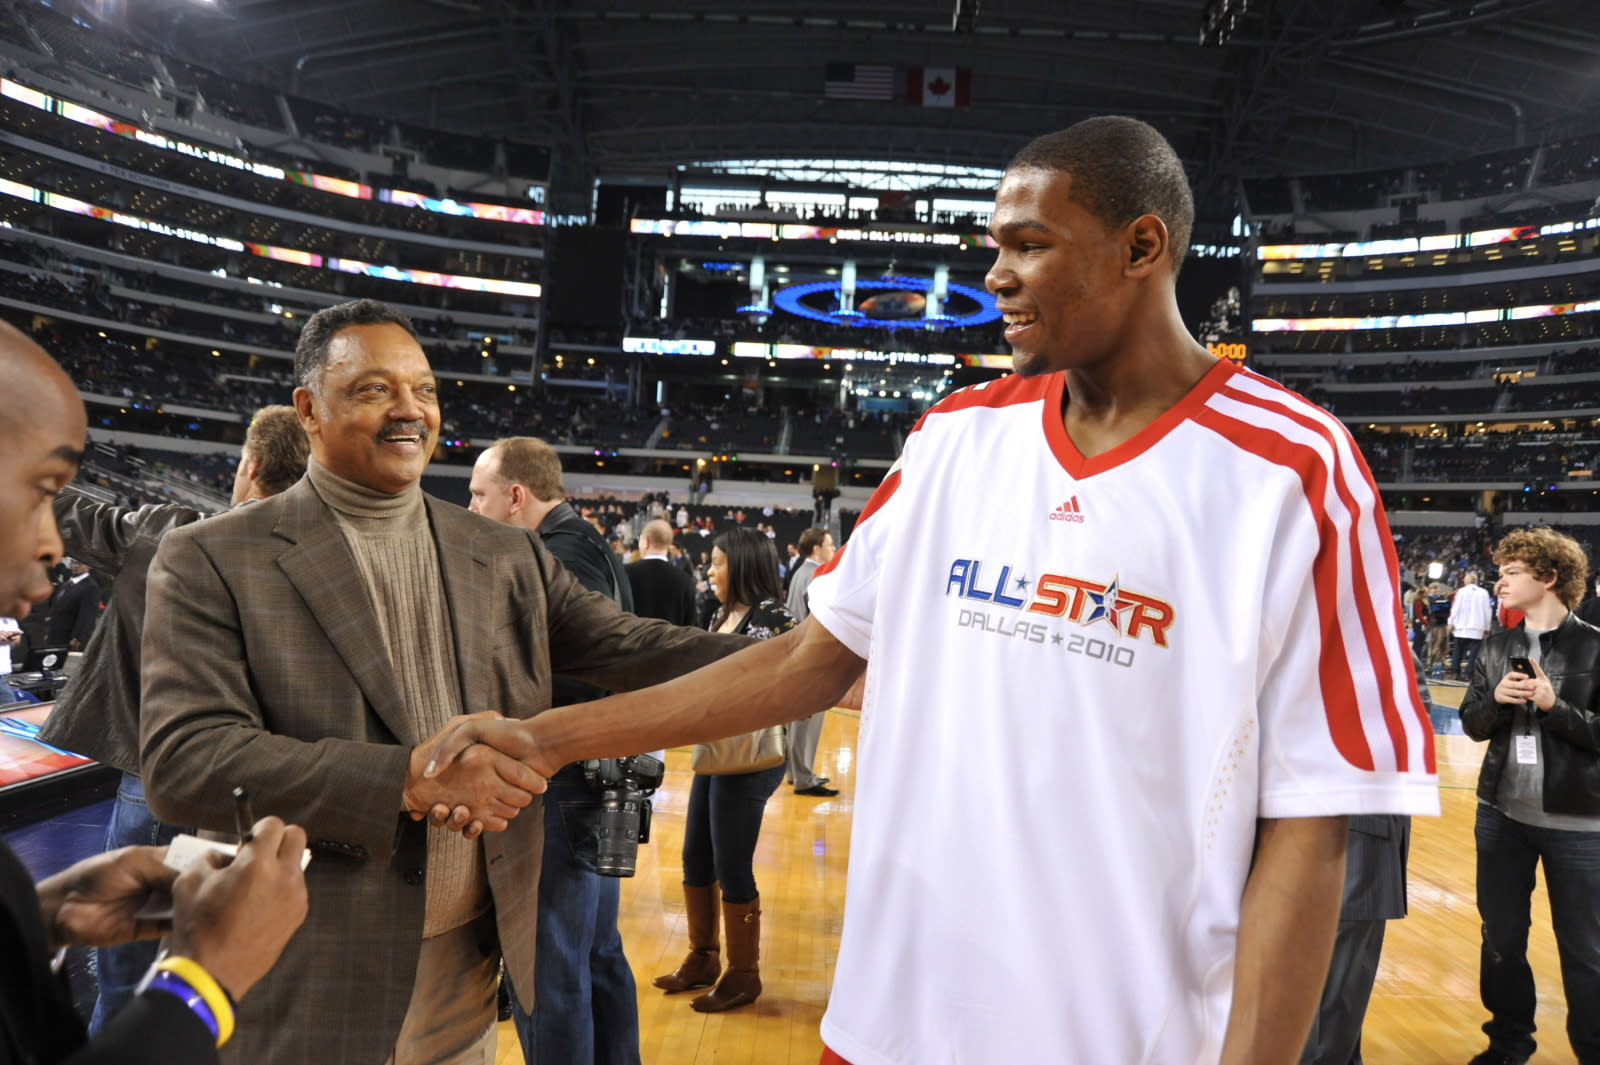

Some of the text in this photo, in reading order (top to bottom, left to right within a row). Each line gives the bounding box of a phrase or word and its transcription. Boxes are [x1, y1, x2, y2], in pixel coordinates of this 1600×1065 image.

[1049, 511, 1085, 524] adidas
[946, 559, 1176, 649] ALL STAR
[957, 608, 1136, 668] DALLAS 2010
